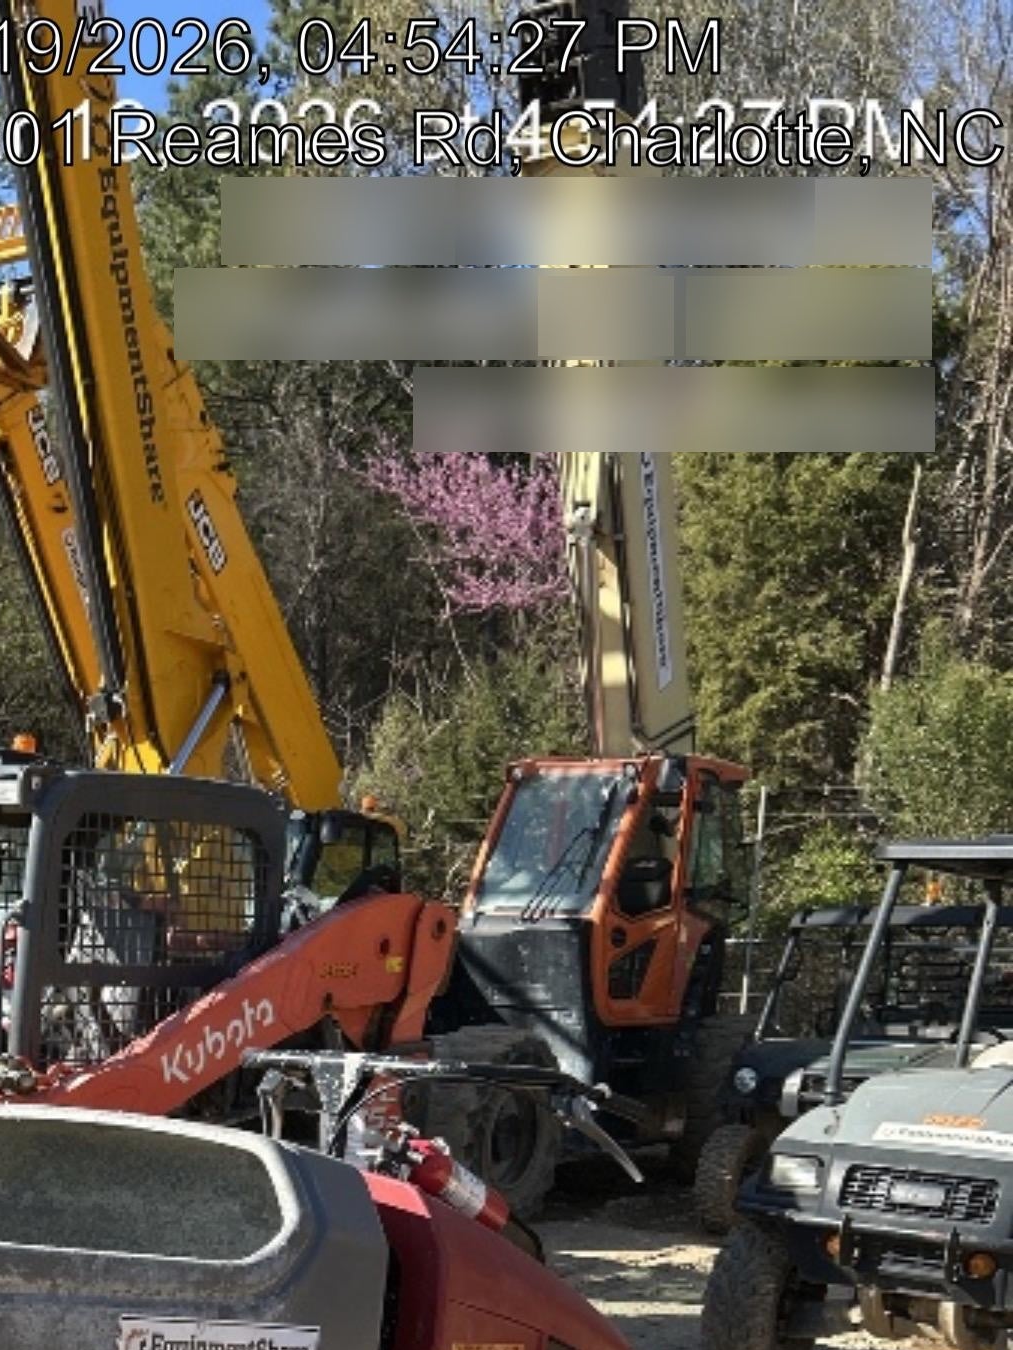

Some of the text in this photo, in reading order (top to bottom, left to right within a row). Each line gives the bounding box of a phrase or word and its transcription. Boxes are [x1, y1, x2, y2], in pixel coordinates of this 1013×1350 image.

[97, 165, 166, 505] EquipmentShare
[186, 488, 228, 575] JCB
[161, 998, 274, 1084] Kubota
